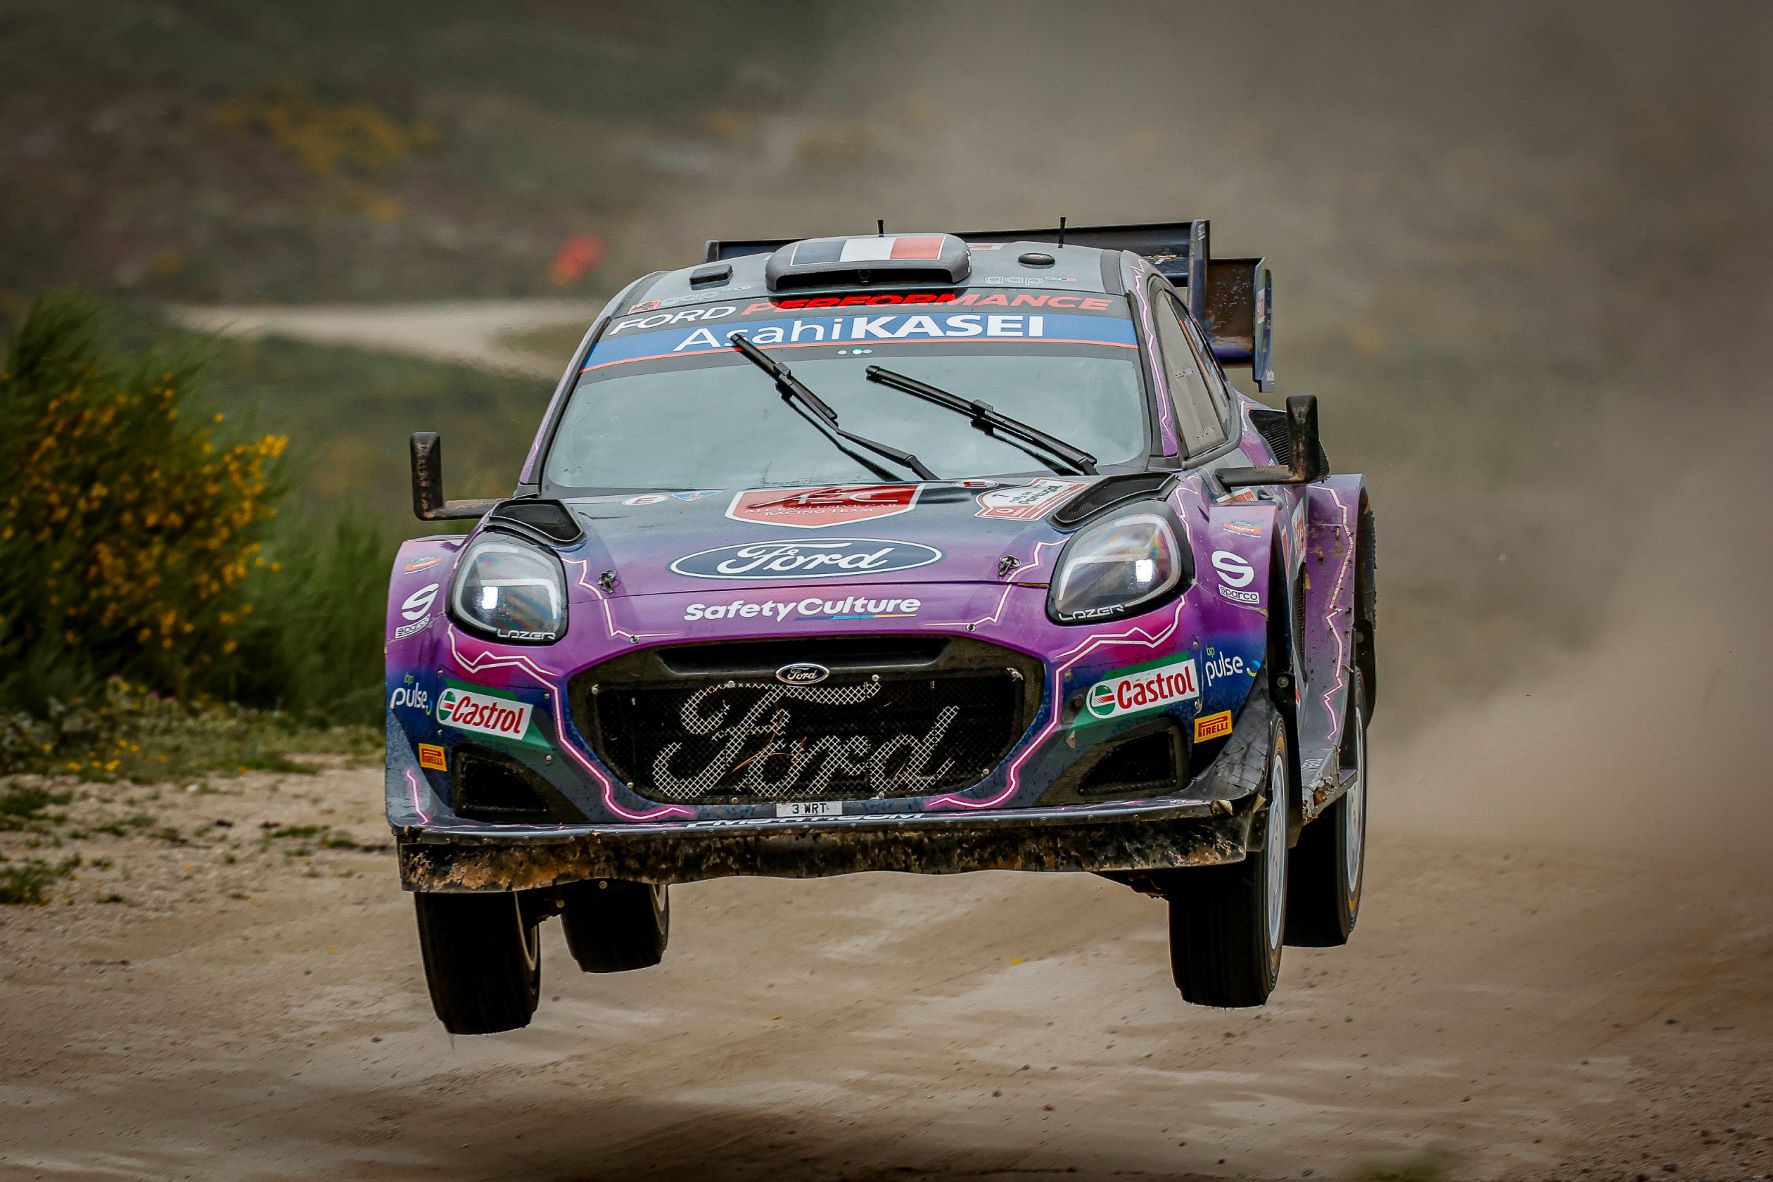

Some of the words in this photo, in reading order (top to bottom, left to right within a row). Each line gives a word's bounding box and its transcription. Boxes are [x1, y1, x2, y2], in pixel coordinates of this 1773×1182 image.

[609, 306, 737, 336] FORD
[740, 293, 1113, 317] PERFORMANCE
[716, 542, 896, 574] Ford
[787, 666, 818, 681] Ford
[1205, 649, 1244, 687] pulse
[1116, 665, 1196, 710] Castrol
[452, 695, 524, 735] Castrol
[1197, 714, 1229, 738] PIRELLI
[652, 683, 960, 800] Ford
[792, 803, 800, 814] 3
[804, 802, 827, 815] WRT
